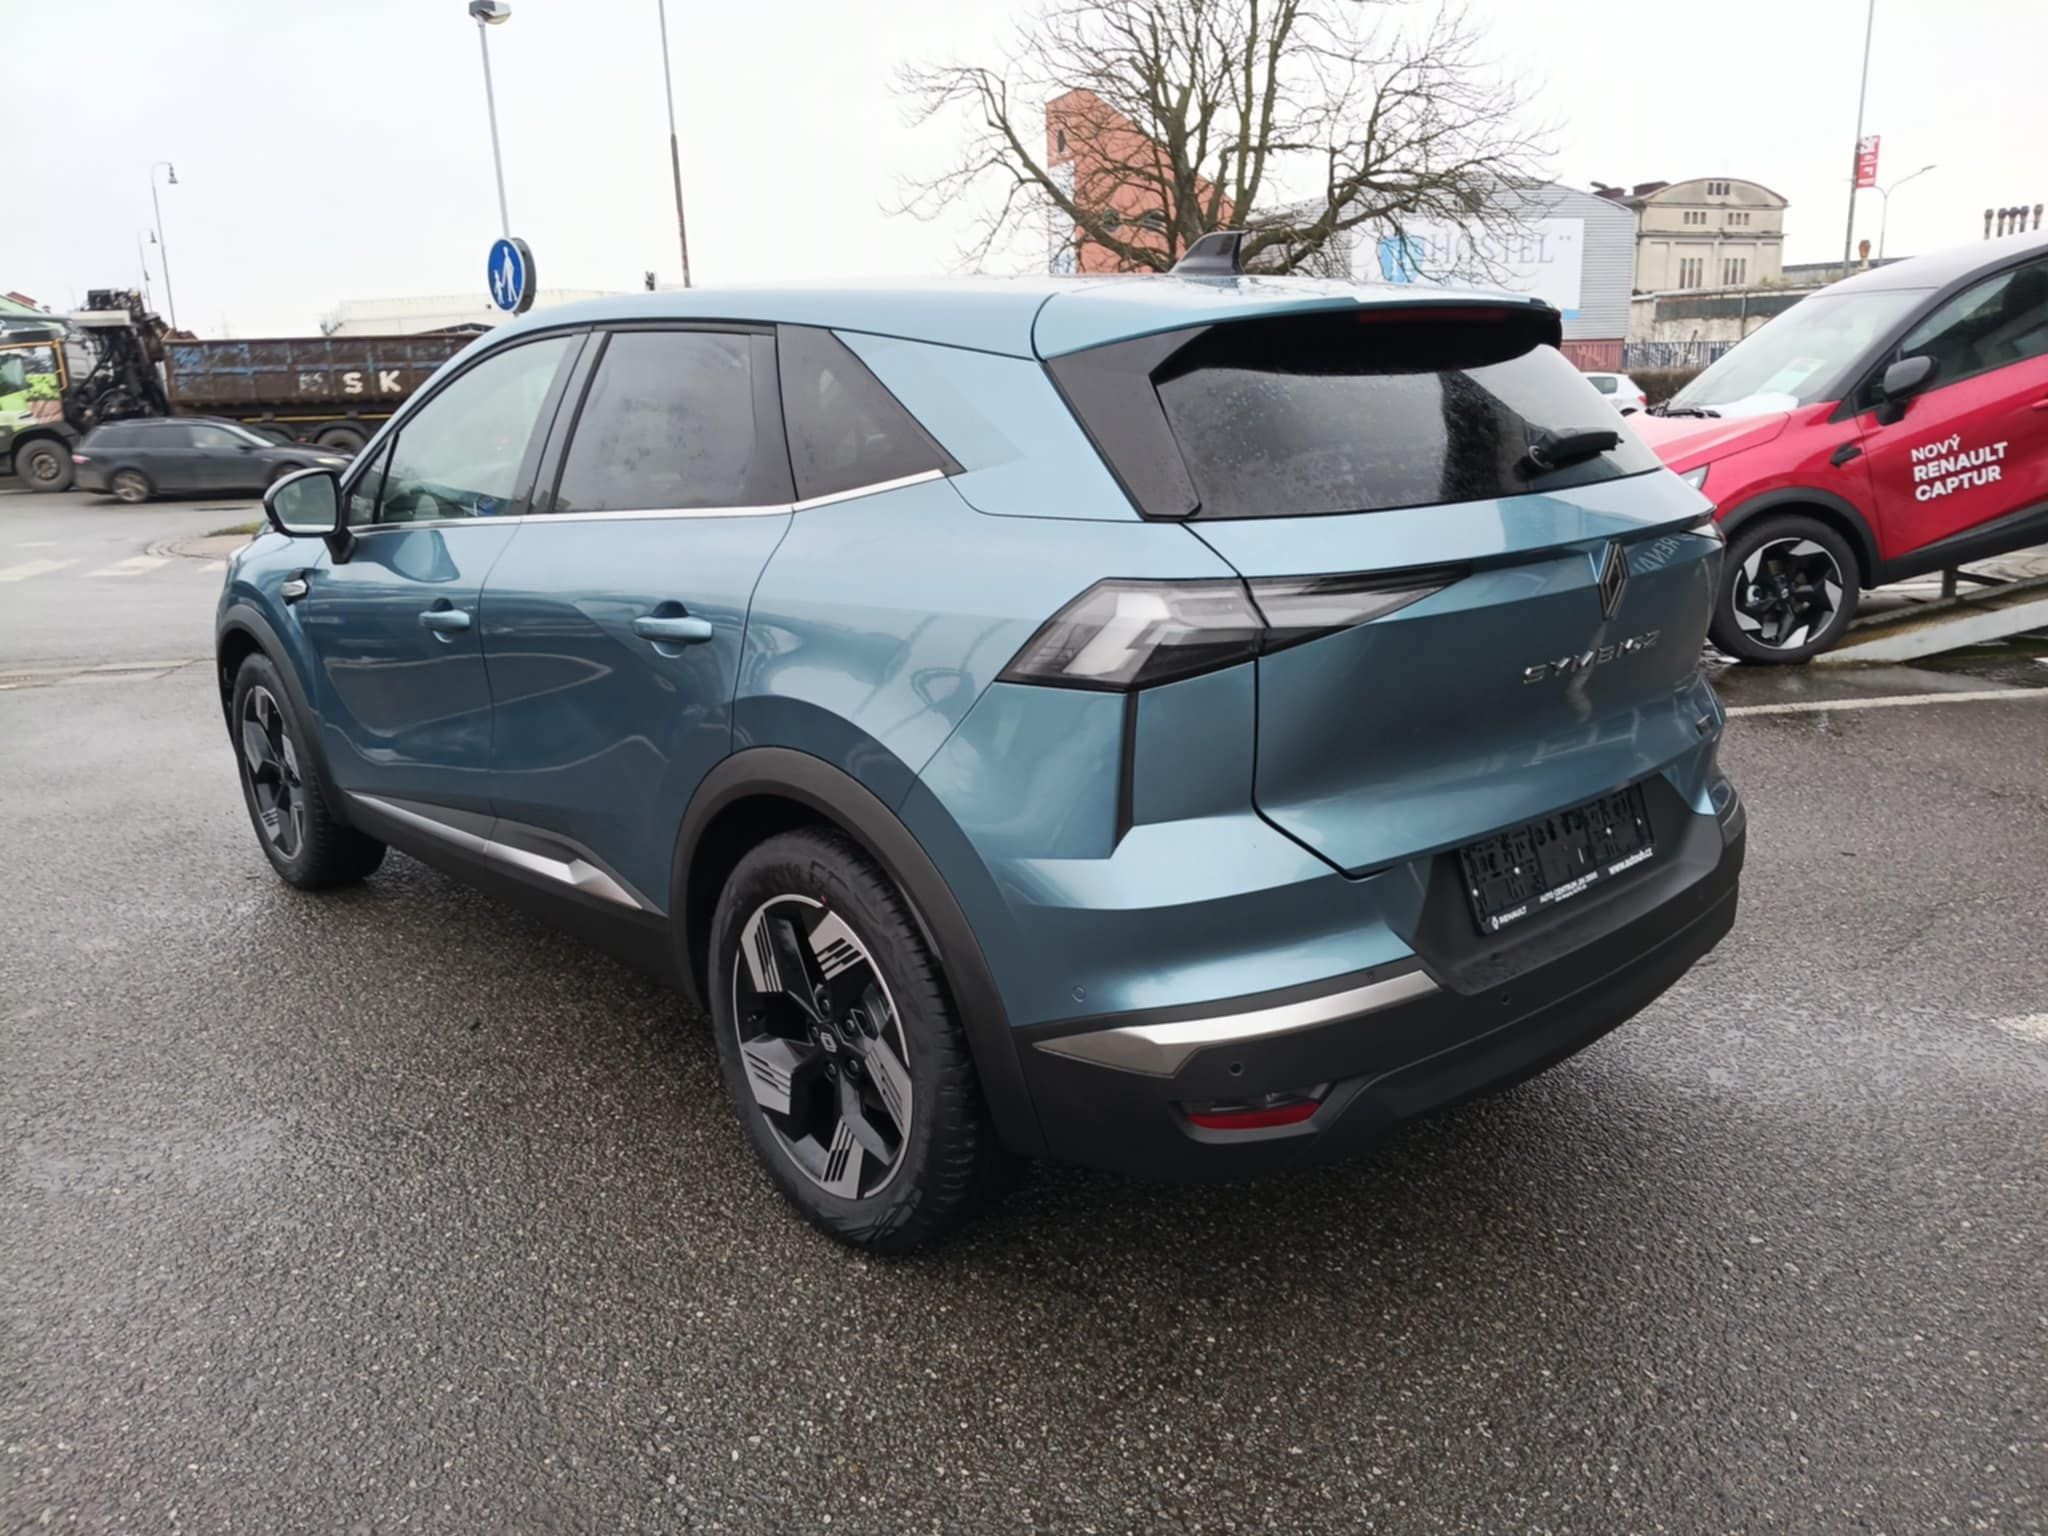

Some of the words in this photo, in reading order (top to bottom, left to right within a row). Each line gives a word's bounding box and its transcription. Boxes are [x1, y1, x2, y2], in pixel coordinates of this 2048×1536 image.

[1431, 233, 1554, 264] HOSTEL
[1911, 433, 1960, 462] NOVÝ
[1913, 441, 2008, 482] RENAULT
[1915, 465, 2002, 501] CAPTUR
